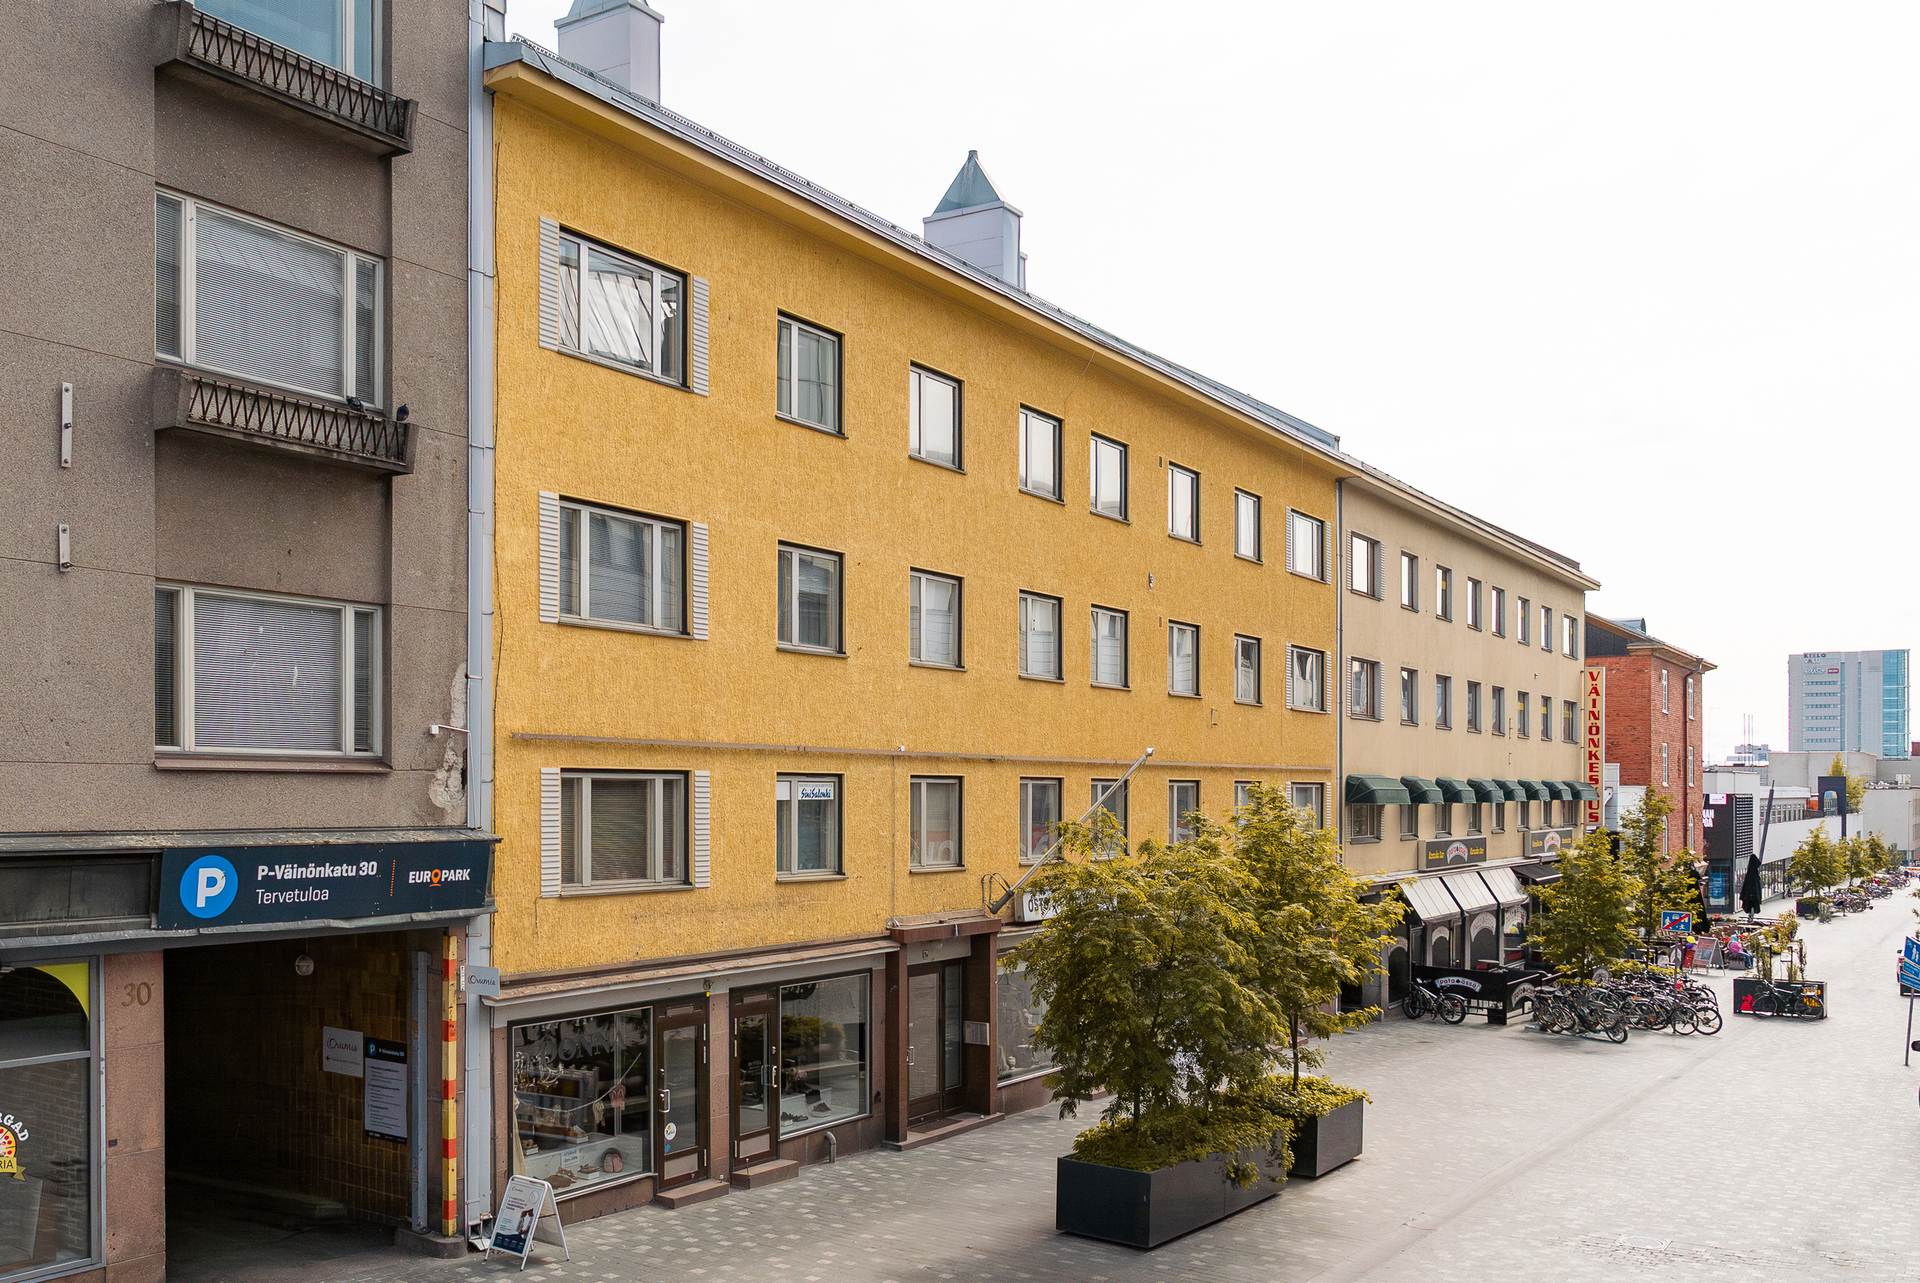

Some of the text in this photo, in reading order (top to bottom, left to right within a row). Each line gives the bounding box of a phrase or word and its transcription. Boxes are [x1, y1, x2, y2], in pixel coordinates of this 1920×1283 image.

[1587, 671, 1601, 823] VÄINÖNKESUS
[257, 860, 378, 881] P-Väinönkatu 30
[408, 868, 471, 885] EUROPARK
[256, 886, 330, 905] Tervetuloa
[121, 981, 152, 1007] 30
[0, 1112, 30, 1142] GAD
